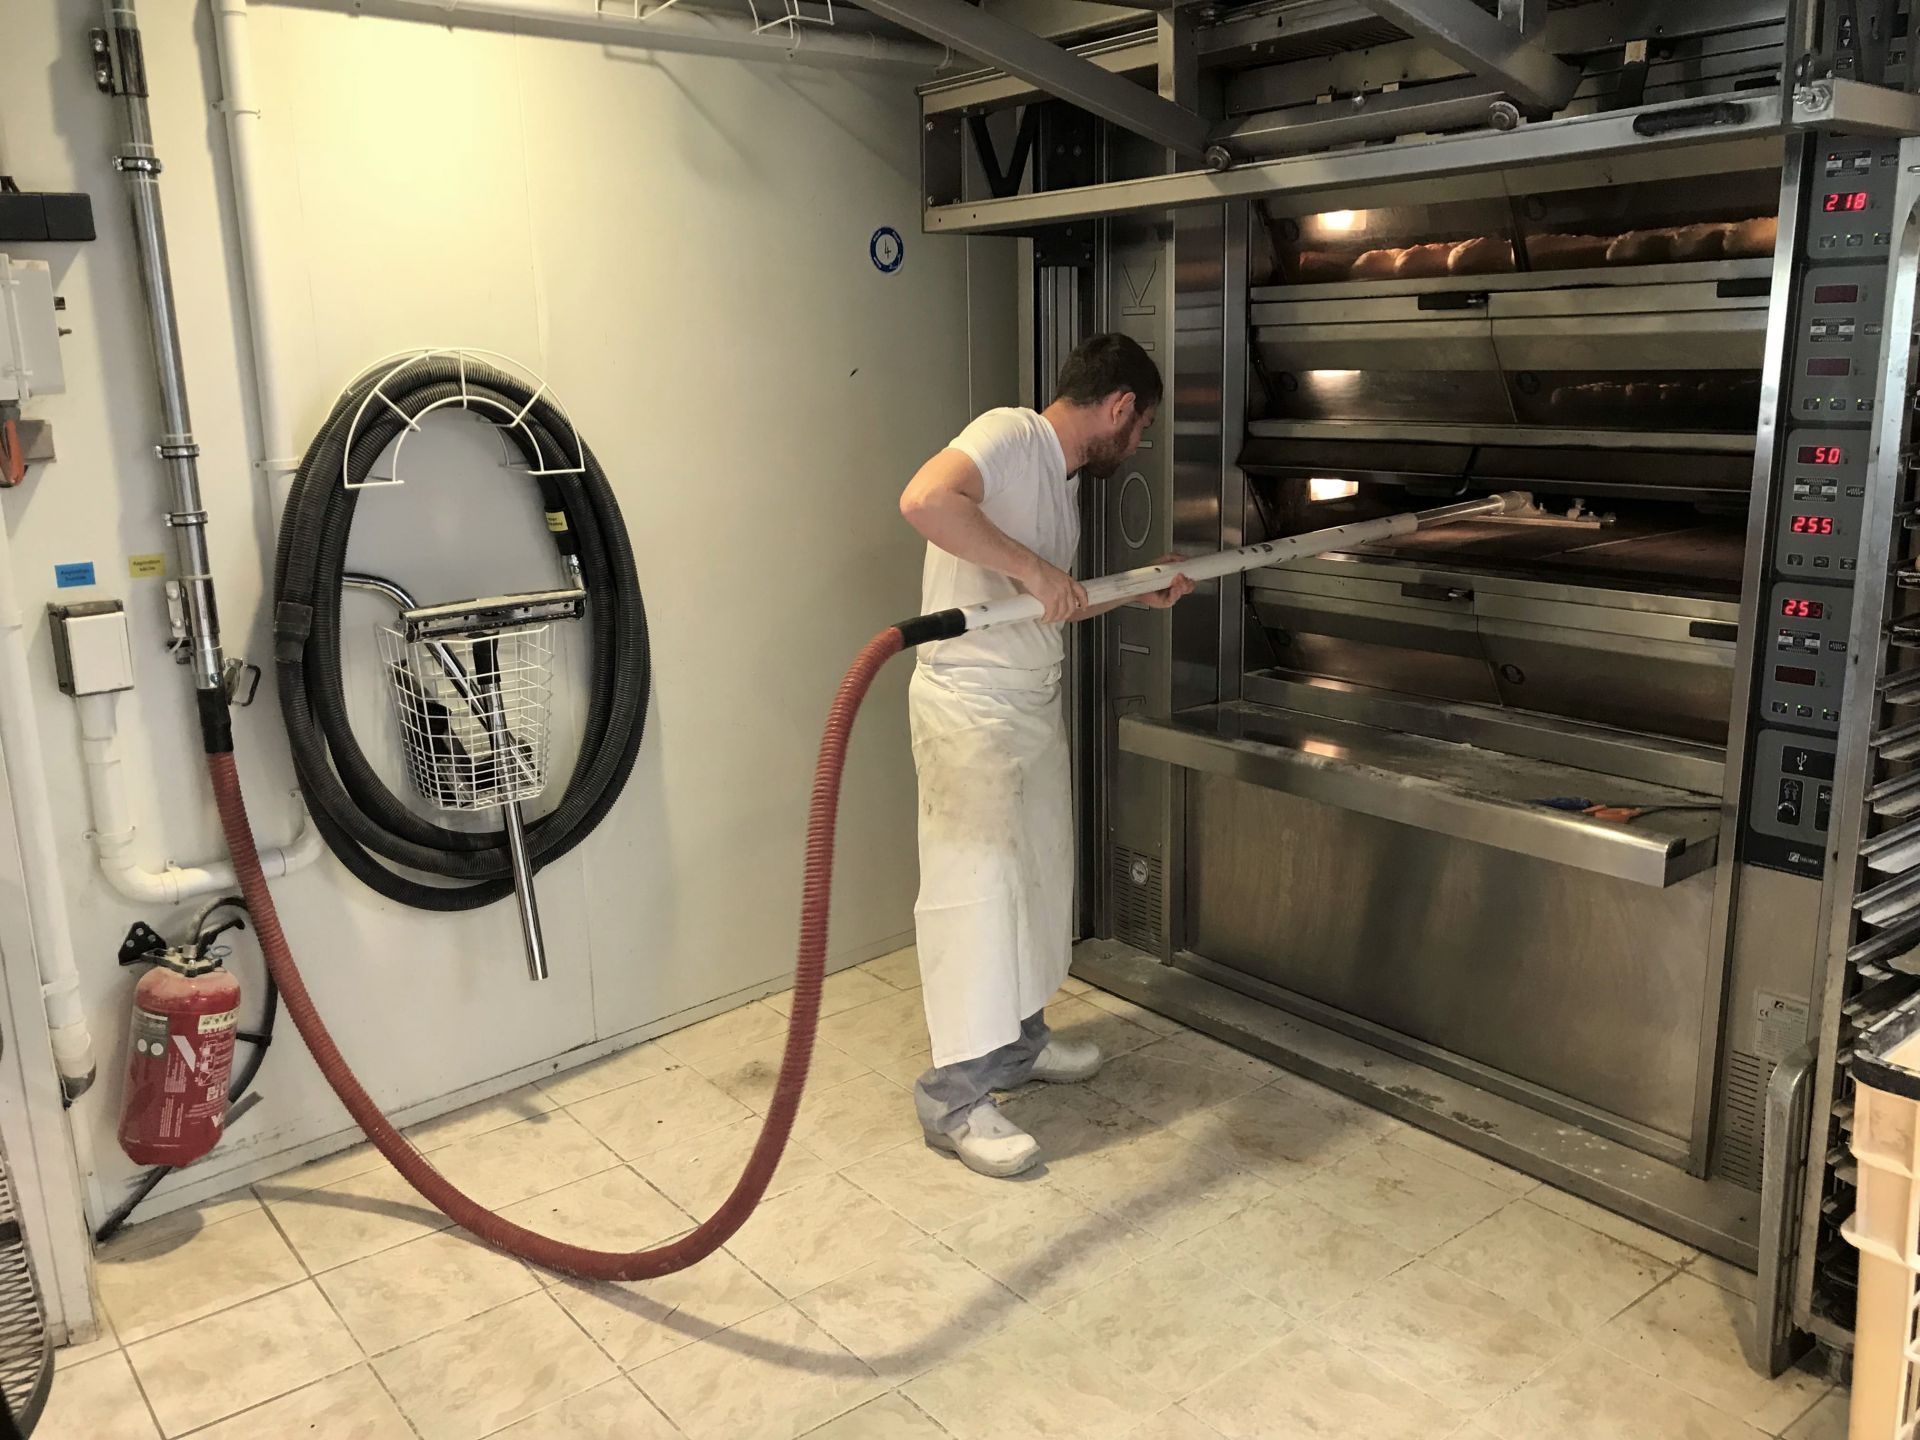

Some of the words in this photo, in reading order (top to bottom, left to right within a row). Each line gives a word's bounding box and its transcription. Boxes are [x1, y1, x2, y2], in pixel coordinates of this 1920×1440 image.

[1826, 192, 1867, 211] 218
[1815, 447, 1841, 464] 50
[1793, 516, 1832, 534] 255
[1784, 599, 1809, 617] 25
